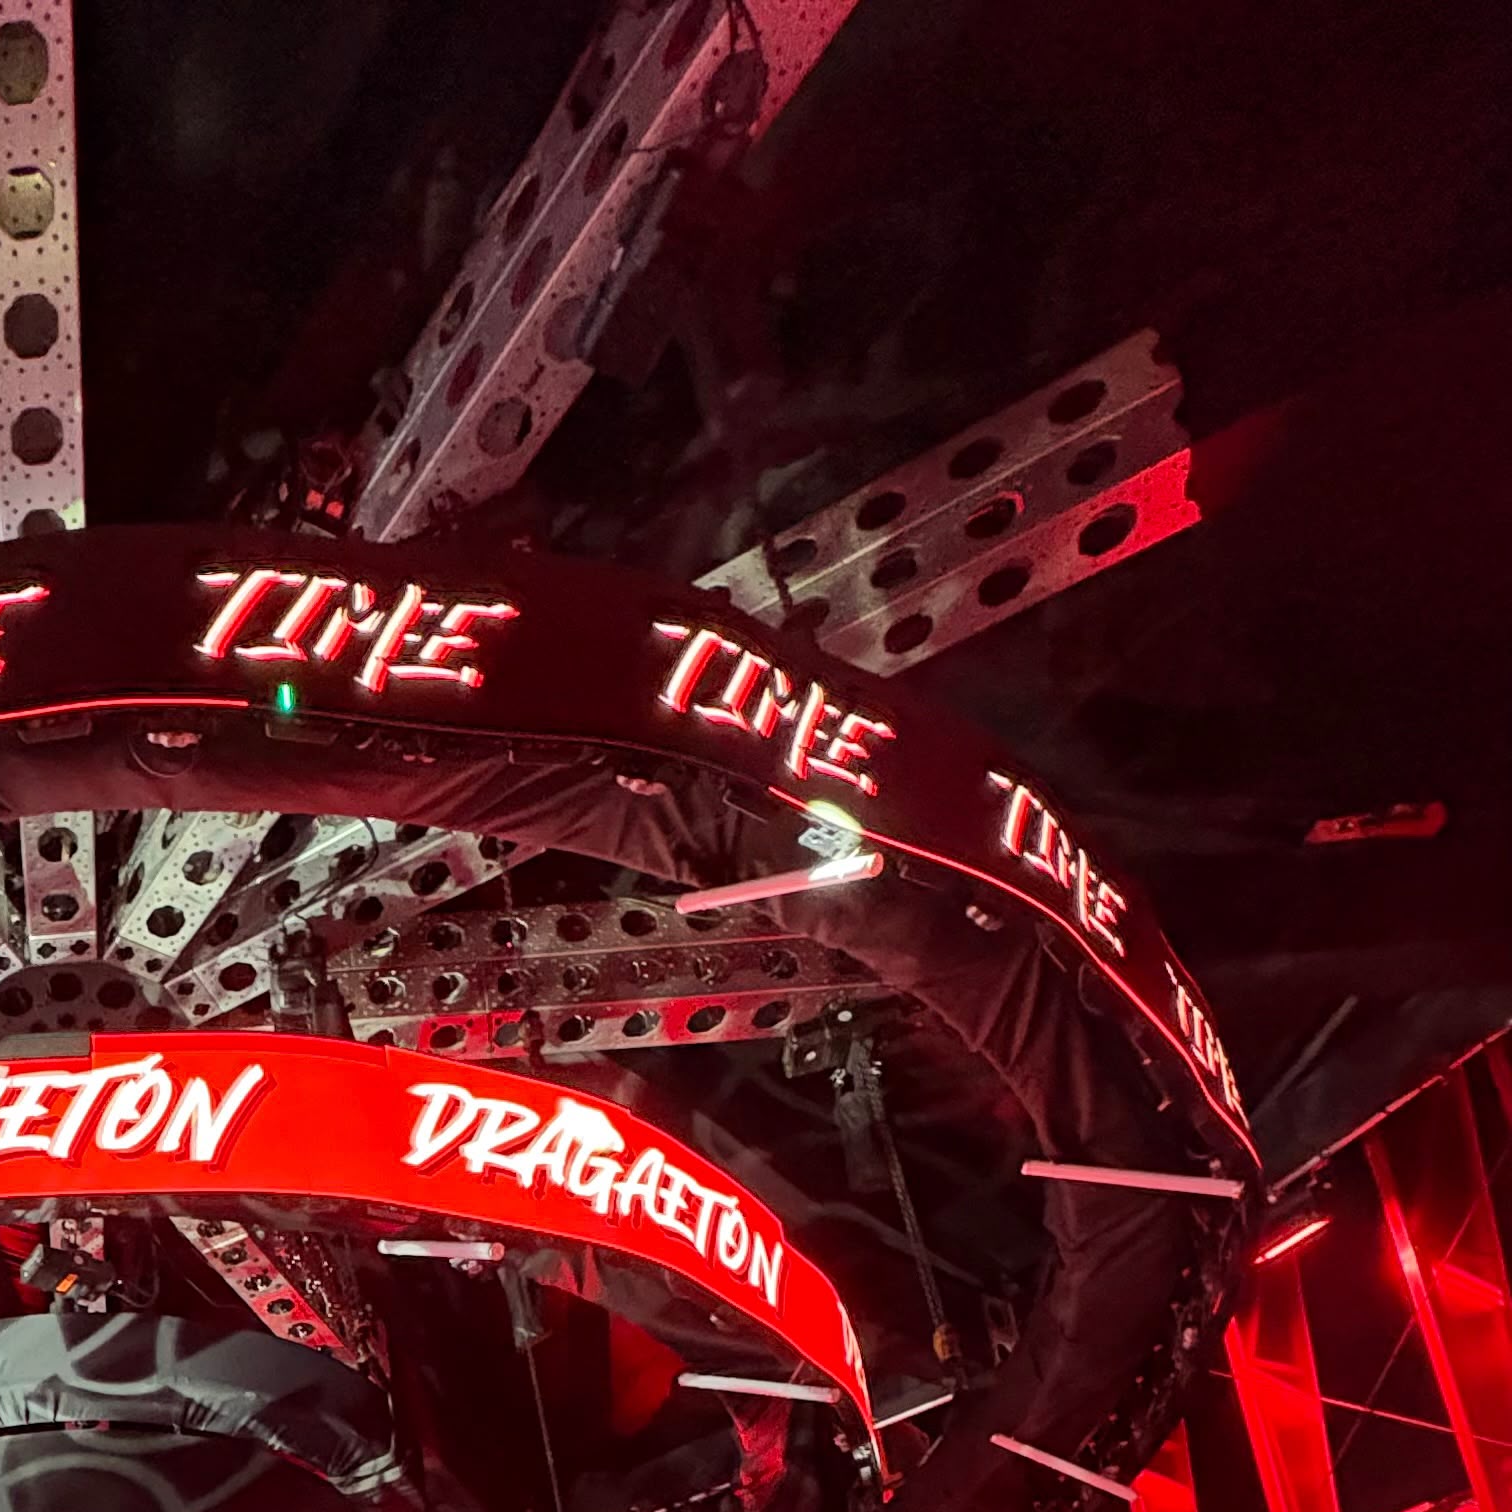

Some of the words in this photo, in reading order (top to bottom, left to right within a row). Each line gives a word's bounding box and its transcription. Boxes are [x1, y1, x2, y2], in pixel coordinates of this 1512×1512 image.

[192, 568, 522, 694] TIME
[651, 621, 898, 797] TIME
[987, 770, 1128, 959] TIME
